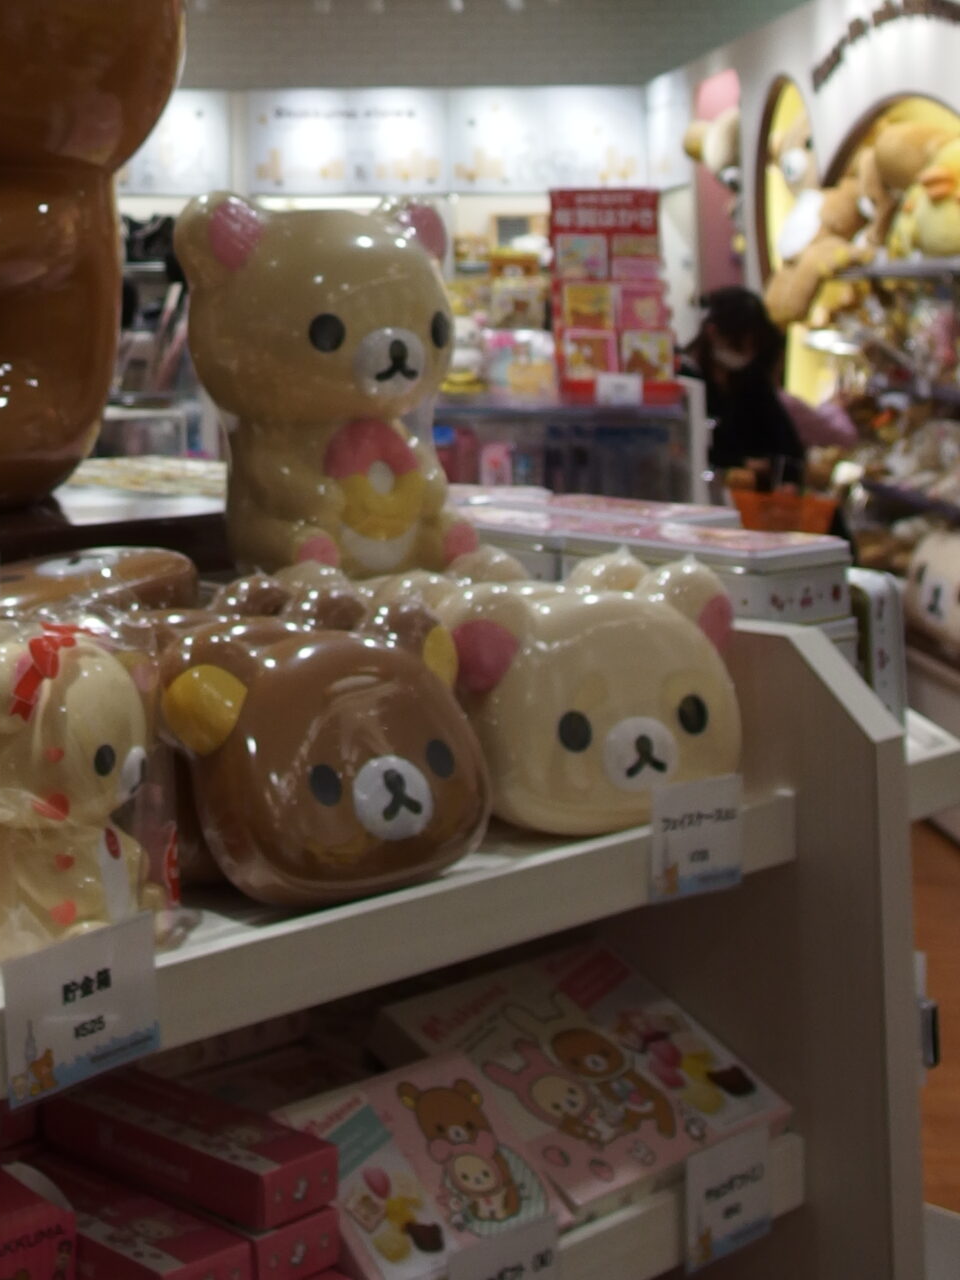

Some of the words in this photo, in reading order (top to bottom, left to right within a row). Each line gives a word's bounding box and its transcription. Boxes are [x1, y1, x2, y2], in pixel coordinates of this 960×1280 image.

[62, 968, 112, 1006] 貯金箱
[74, 1015, 107, 1039] ¥525
